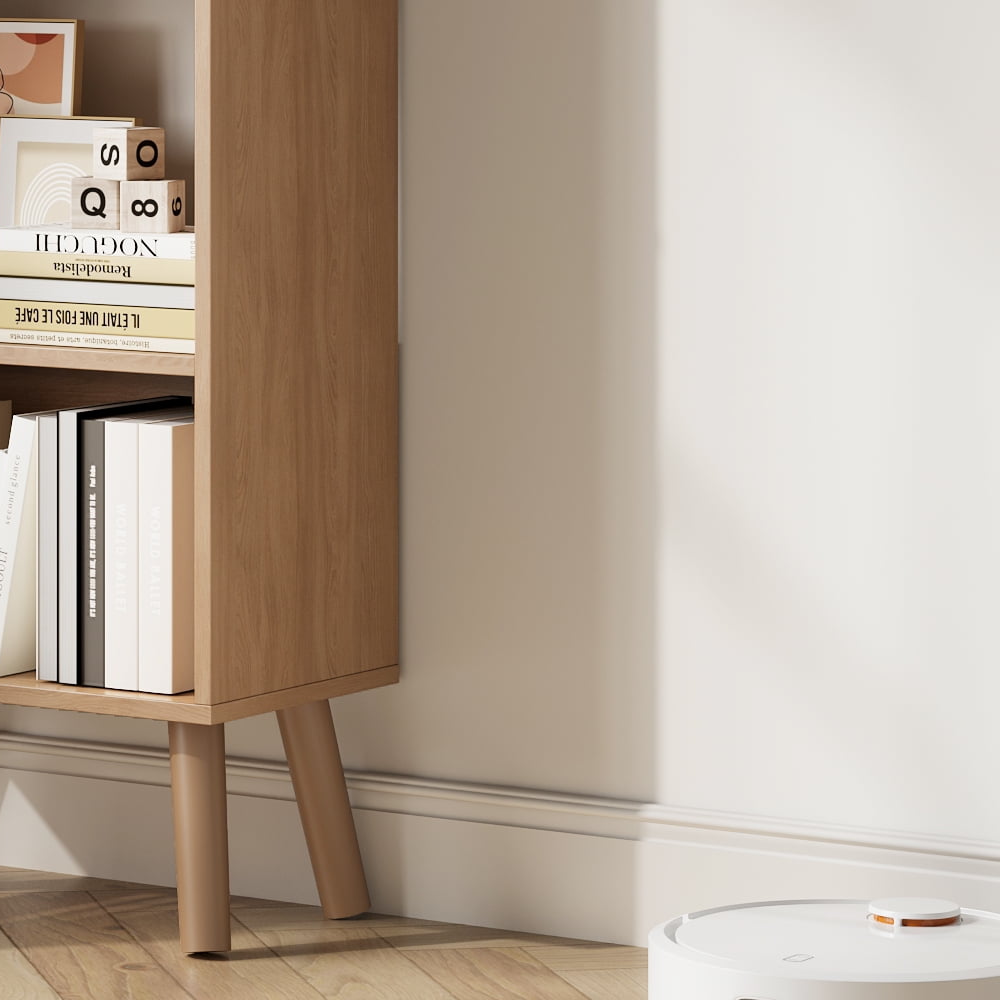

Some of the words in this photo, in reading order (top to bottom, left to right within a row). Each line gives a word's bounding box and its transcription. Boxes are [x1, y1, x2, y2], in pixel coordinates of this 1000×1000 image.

[100, 143, 120, 167] S
[136, 139, 159, 168] O
[80, 187, 107, 219] Q
[131, 198, 159, 218] 8
[35, 233, 158, 257] NOGUCHI
[53, 261, 131, 278] Remodelista
[15, 307, 39, 325] CAFÉ
[41, 308, 53, 323] LE
[55, 309, 77, 325] FOIS
[79, 310, 99, 326] UNE
[101, 311, 128, 331] ÉTAIT
[130, 313, 140, 329] IL
[4, 490, 15, 525] second
[10, 454, 21, 488] glance
